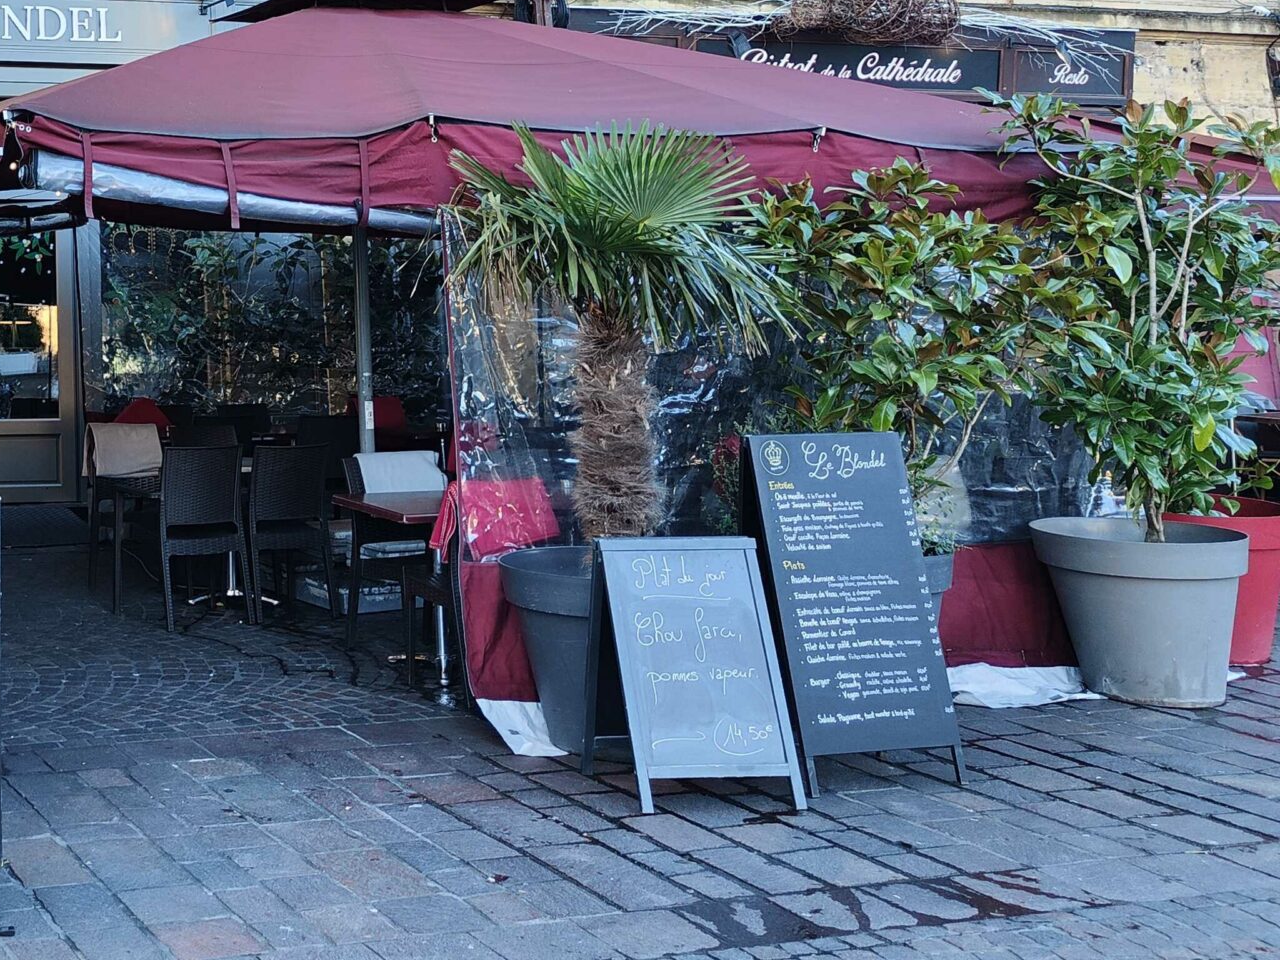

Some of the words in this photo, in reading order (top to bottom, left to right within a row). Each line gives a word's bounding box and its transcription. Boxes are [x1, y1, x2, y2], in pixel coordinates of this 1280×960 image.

[838, 64, 852, 78] la
[856, 52, 962, 83] Cathédrale
[1048, 63, 1089, 85] Resto
[801, 440, 834, 479] Le
[832, 444, 887, 478] Blondel
[631, 555, 671, 589] Plat
[677, 555, 694, 585] du
[699, 564, 726, 597] jour
[782, 560, 805, 570] Plats
[634, 611, 684, 646] Chou
[647, 671, 699, 705] pommes
[809, 678, 831, 688] Burger
